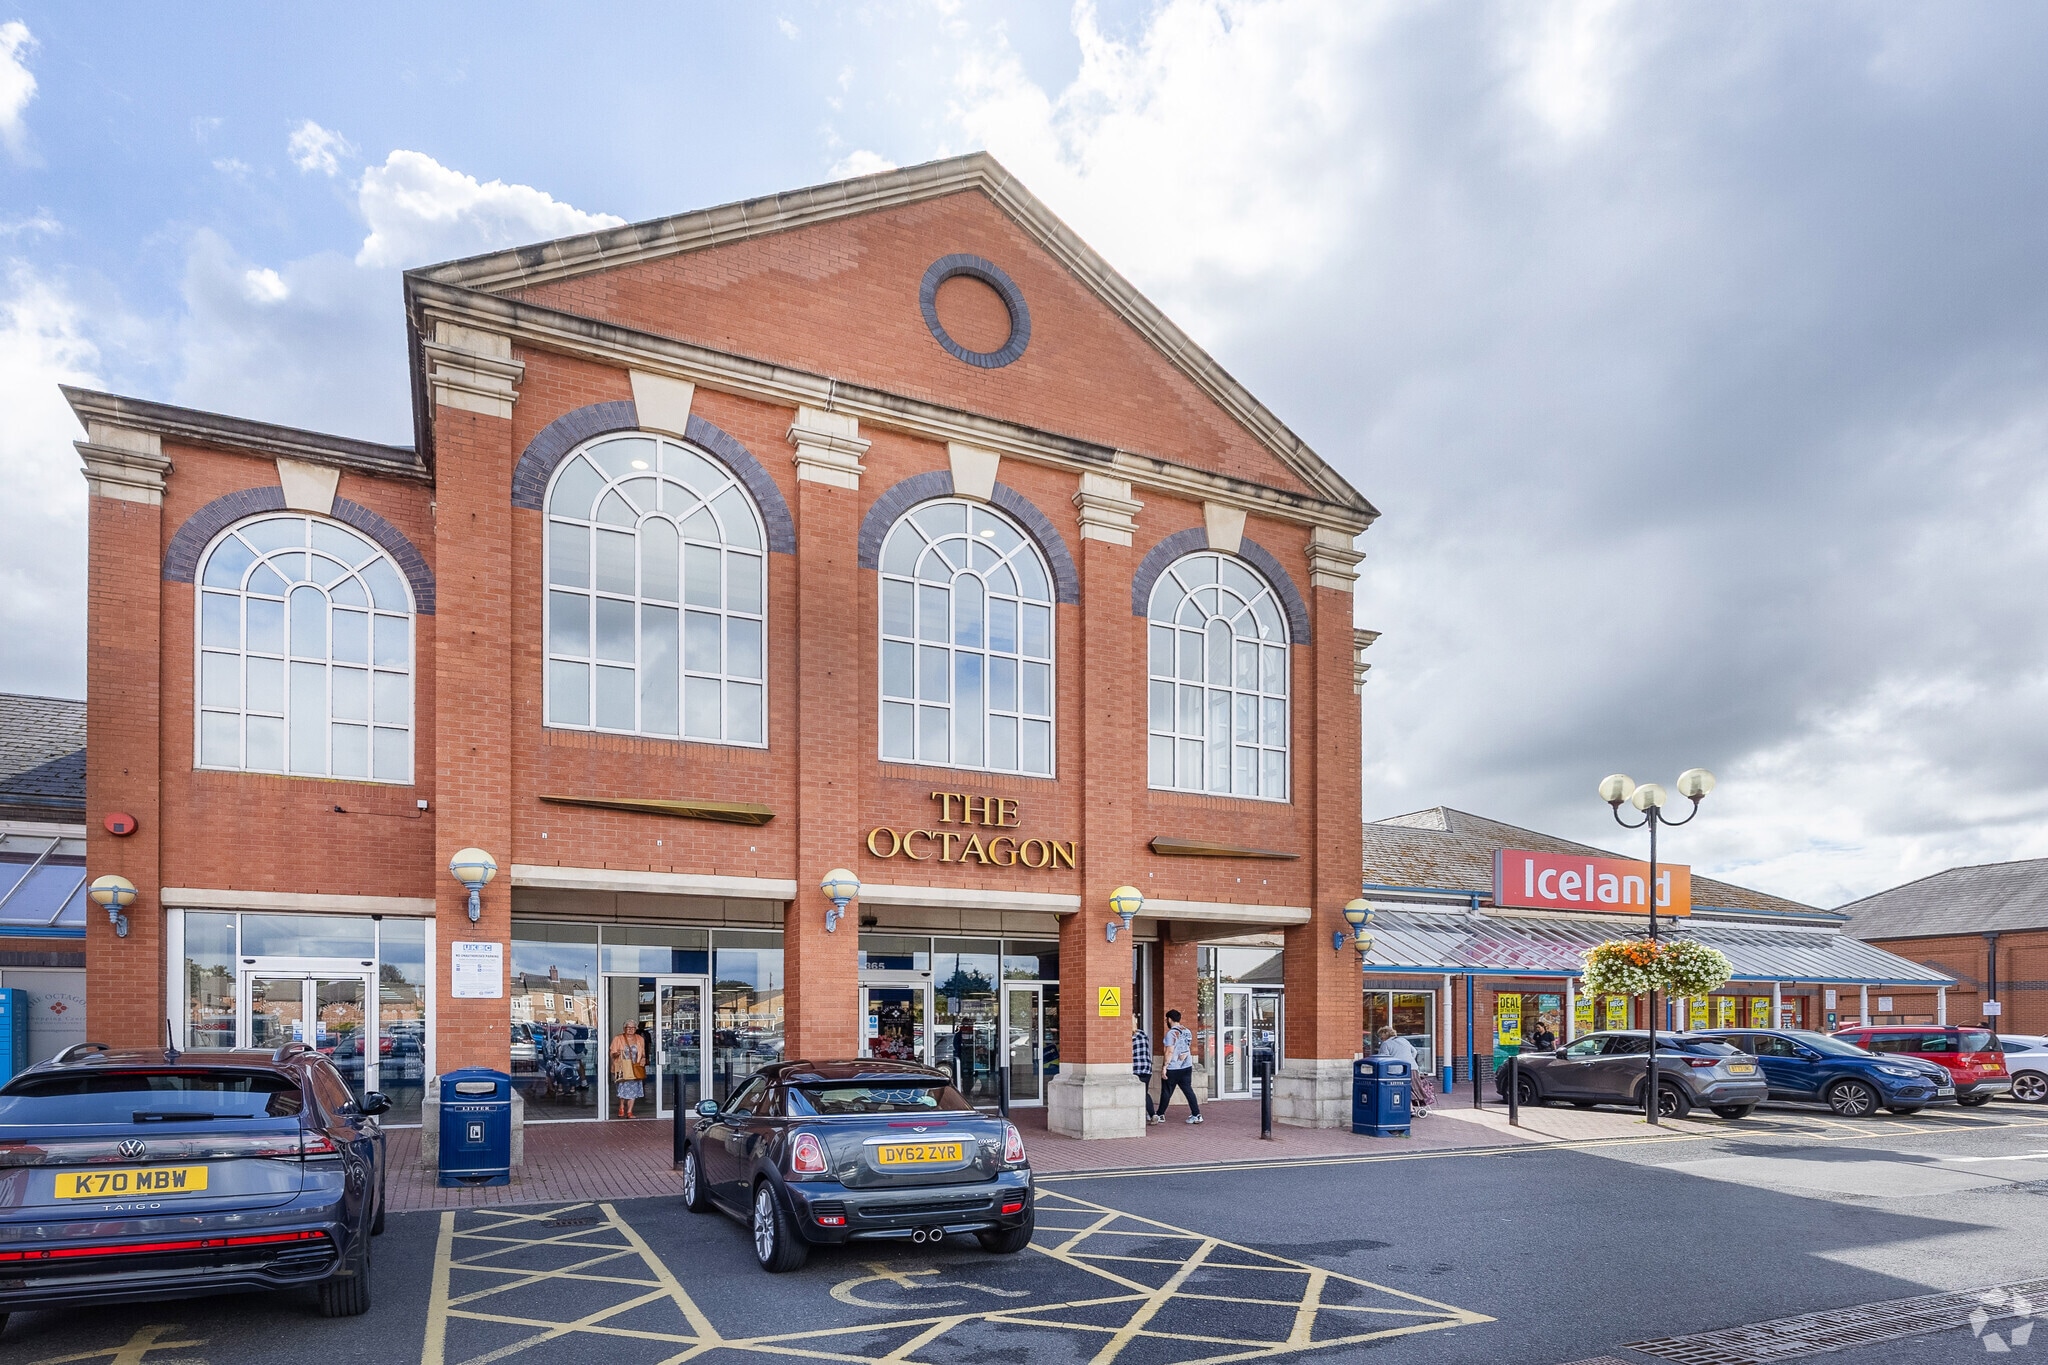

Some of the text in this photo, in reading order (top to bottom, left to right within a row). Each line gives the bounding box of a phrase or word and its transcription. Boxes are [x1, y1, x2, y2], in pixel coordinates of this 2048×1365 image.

[931, 791, 1022, 828] THE
[867, 826, 1079, 870] OCTAGON
[1525, 859, 1671, 907] Iceland
[45, 993, 86, 1006] OCTAGO
[1500, 997, 1520, 1008] DEAL
[886, 1145, 957, 1162] DY62 ZYR
[75, 1170, 187, 1194] K70 MBW
[102, 1202, 161, 1211] TAIGO
